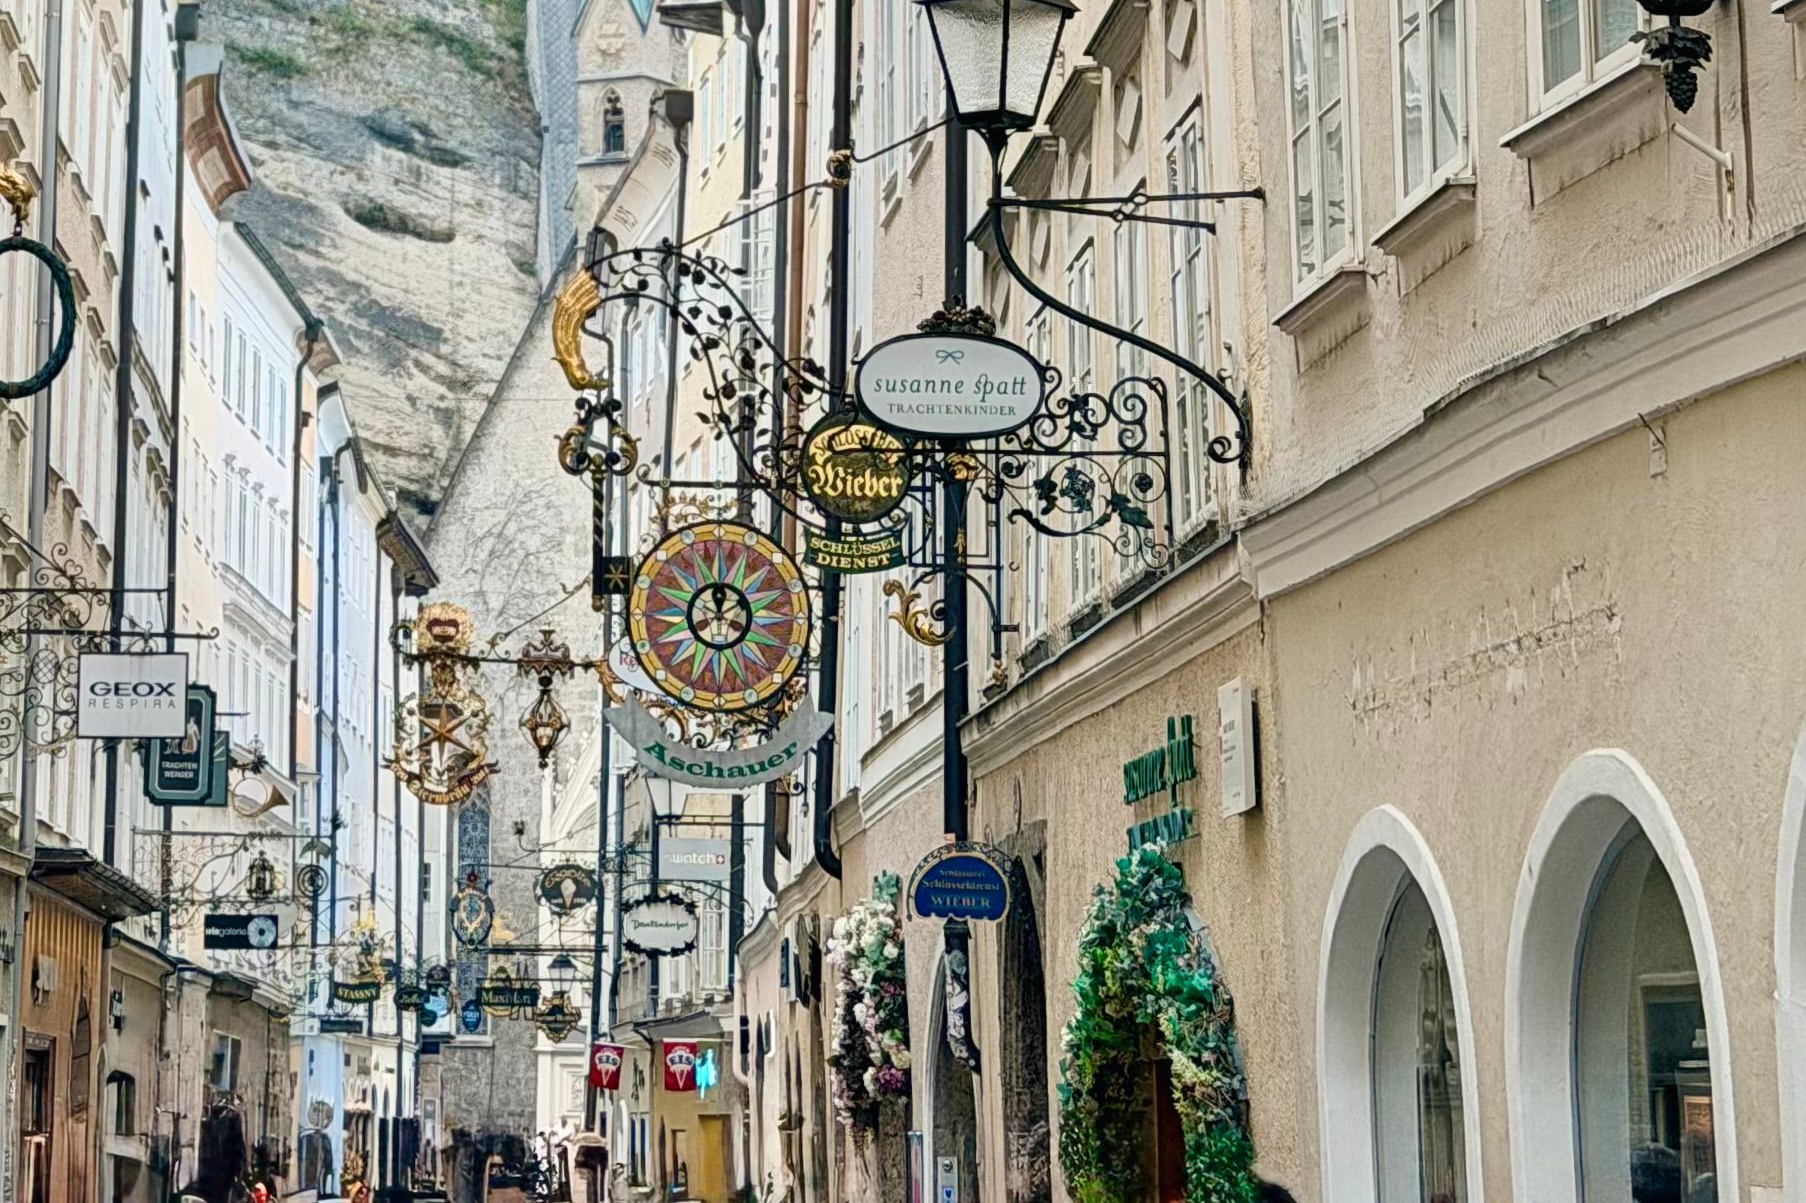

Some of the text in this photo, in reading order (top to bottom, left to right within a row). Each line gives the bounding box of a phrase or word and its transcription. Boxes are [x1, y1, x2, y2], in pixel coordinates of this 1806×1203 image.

[873, 373, 1027, 403] susanne spatt
[888, 403, 1017, 416] TRACHTENKINDER
[808, 461, 904, 497] Wieber
[810, 536, 900, 555] SCHLÜSSEL
[816, 552, 891, 569] DIENST
[89, 681, 177, 697] GEOX
[88, 698, 177, 709] RESPIRA
[642, 740, 799, 779] Aschauer
[662, 852, 716, 865] swatch
[597, 1054, 619, 1067] EIS
[668, 1054, 694, 1067] EIS
